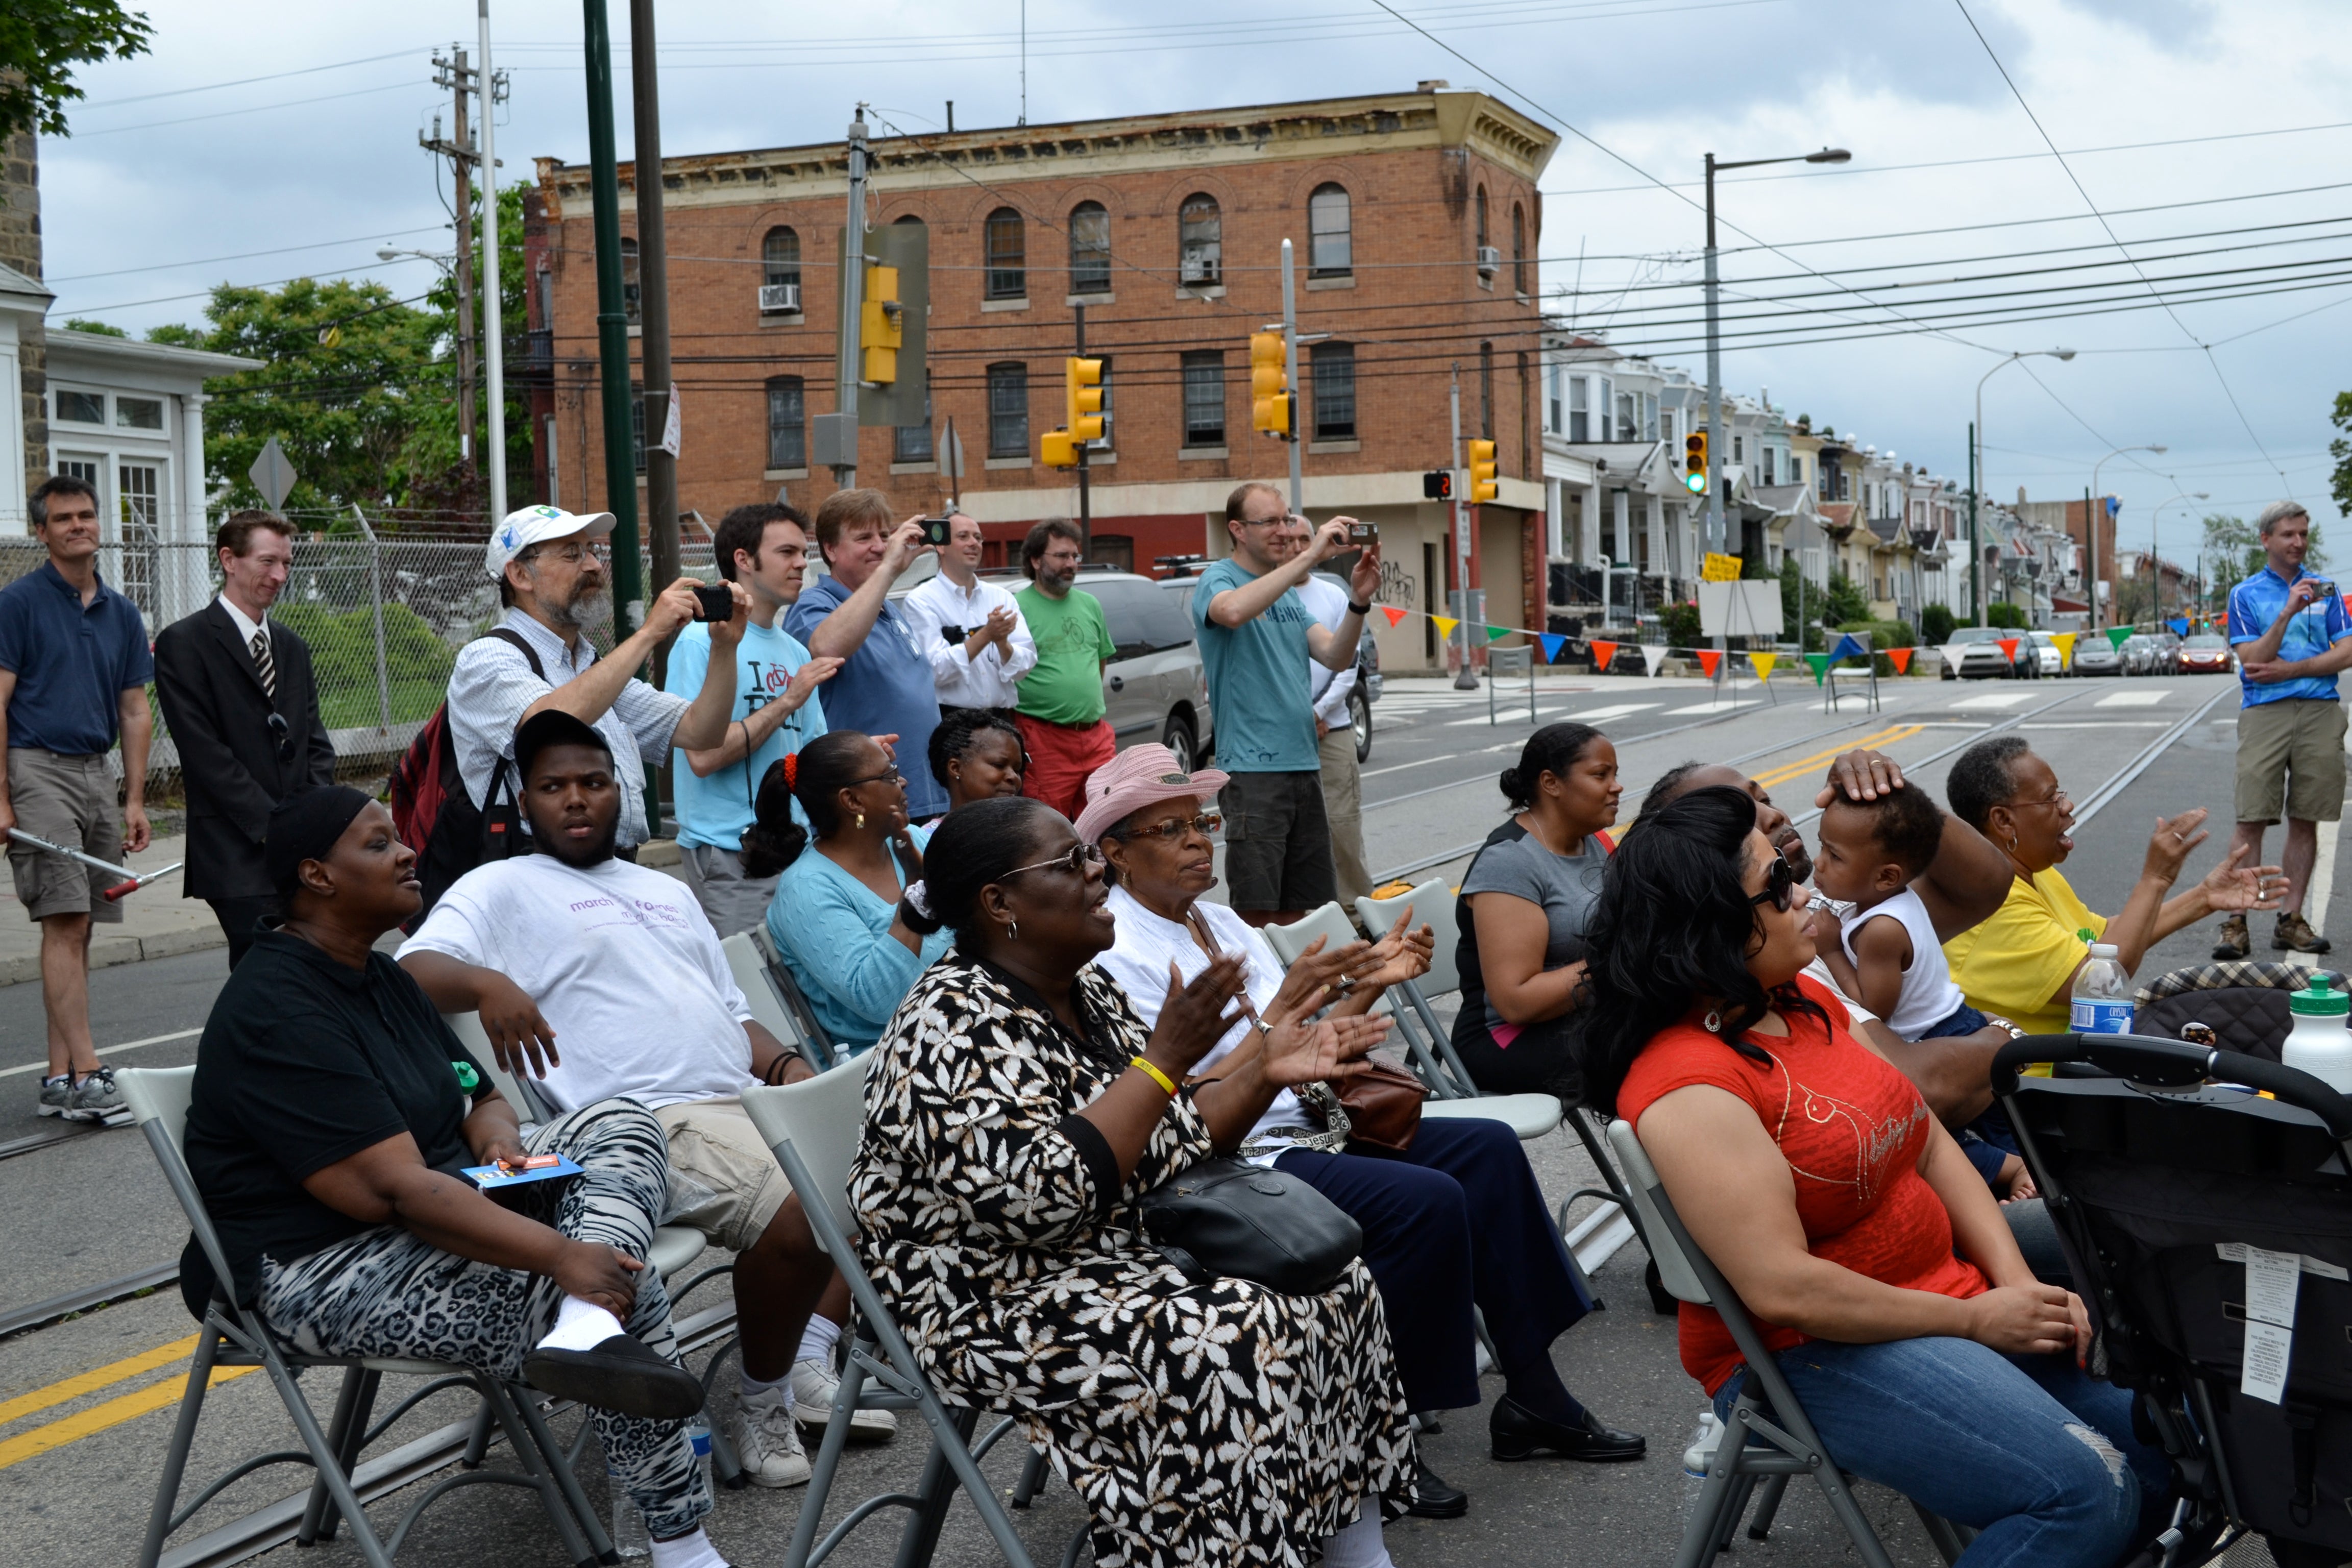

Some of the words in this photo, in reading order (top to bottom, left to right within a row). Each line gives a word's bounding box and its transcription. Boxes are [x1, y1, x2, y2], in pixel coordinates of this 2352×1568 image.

[1441, 476, 1450, 495] 2
[747, 661, 765, 692] I
[570, 897, 615, 912] march
